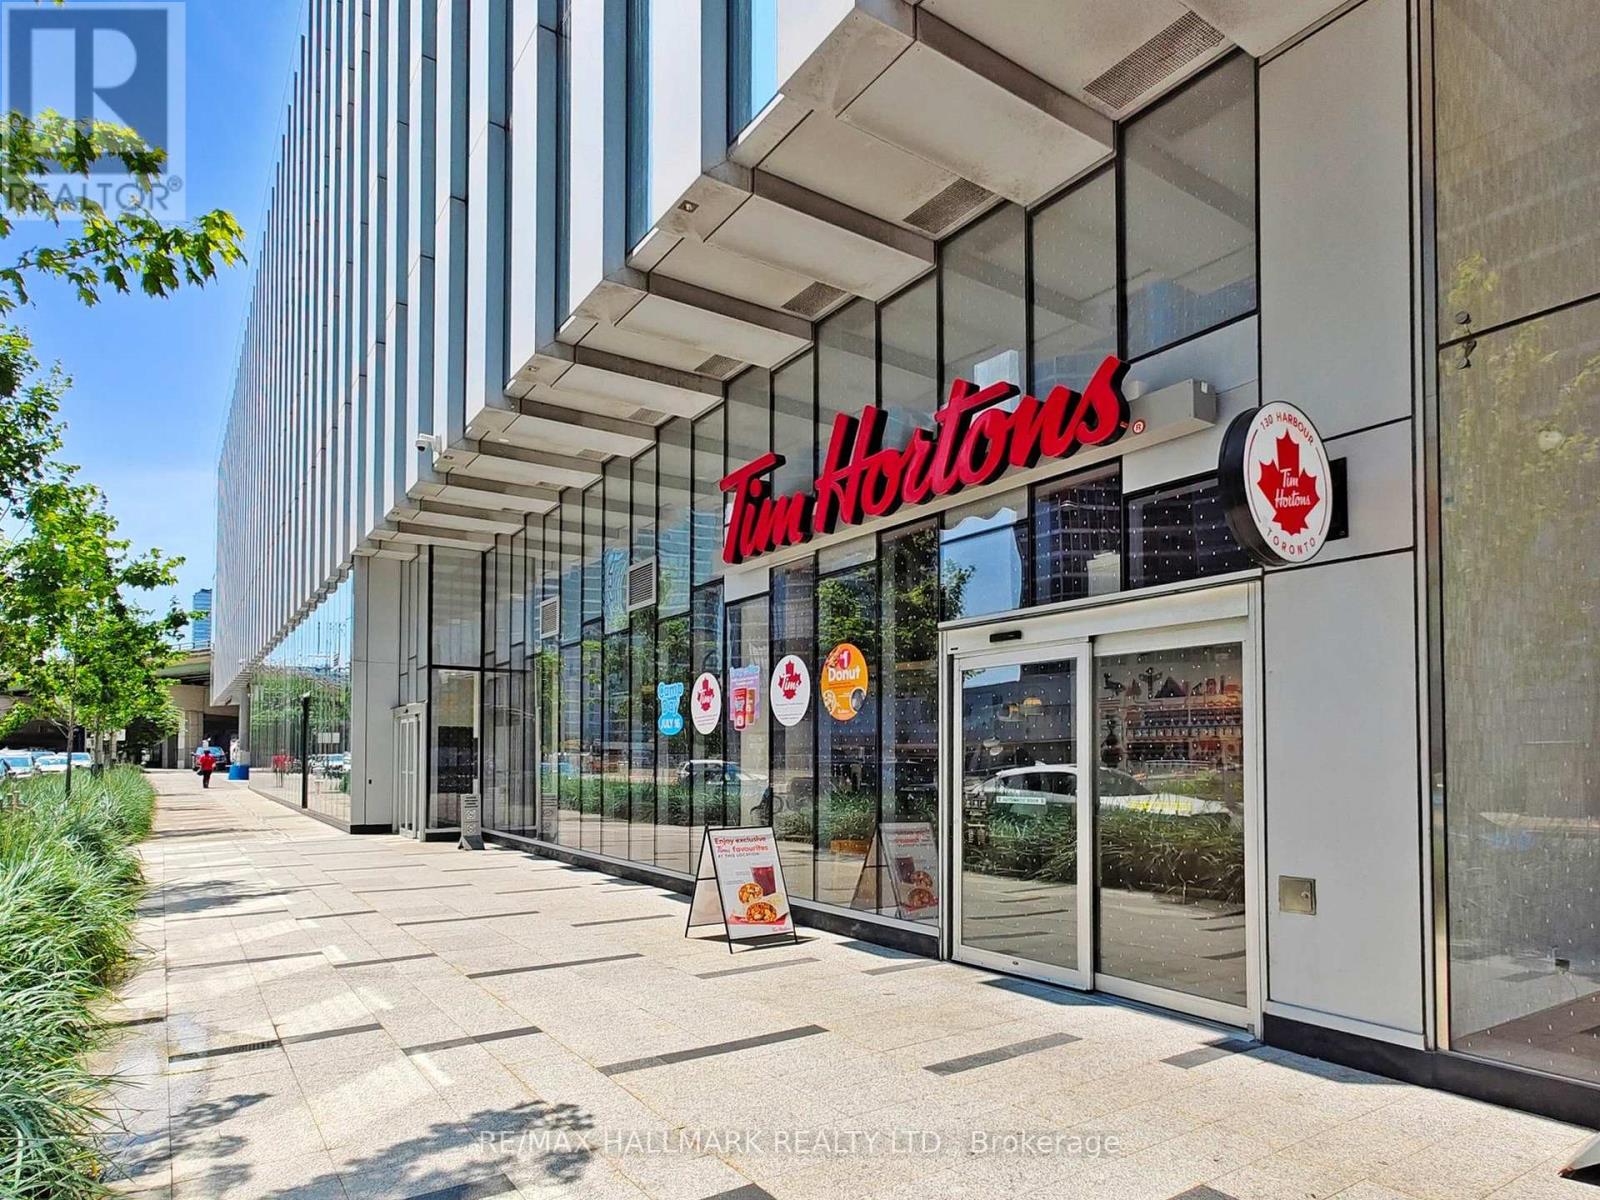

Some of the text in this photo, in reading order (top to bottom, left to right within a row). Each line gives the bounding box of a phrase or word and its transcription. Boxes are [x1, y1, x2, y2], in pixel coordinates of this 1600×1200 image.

[1260, 411, 1314, 446] 130 HARBOUR
[719, 355, 1131, 564] Tim Hortons
[1280, 468, 1299, 488] Tim
[1274, 488, 1311, 508] Hortons
[1266, 527, 1317, 555] TORONTO
[828, 665, 861, 682] Donut
[714, 835, 767, 846] Enjoy exclusive
[732, 844, 769, 853] favourites
